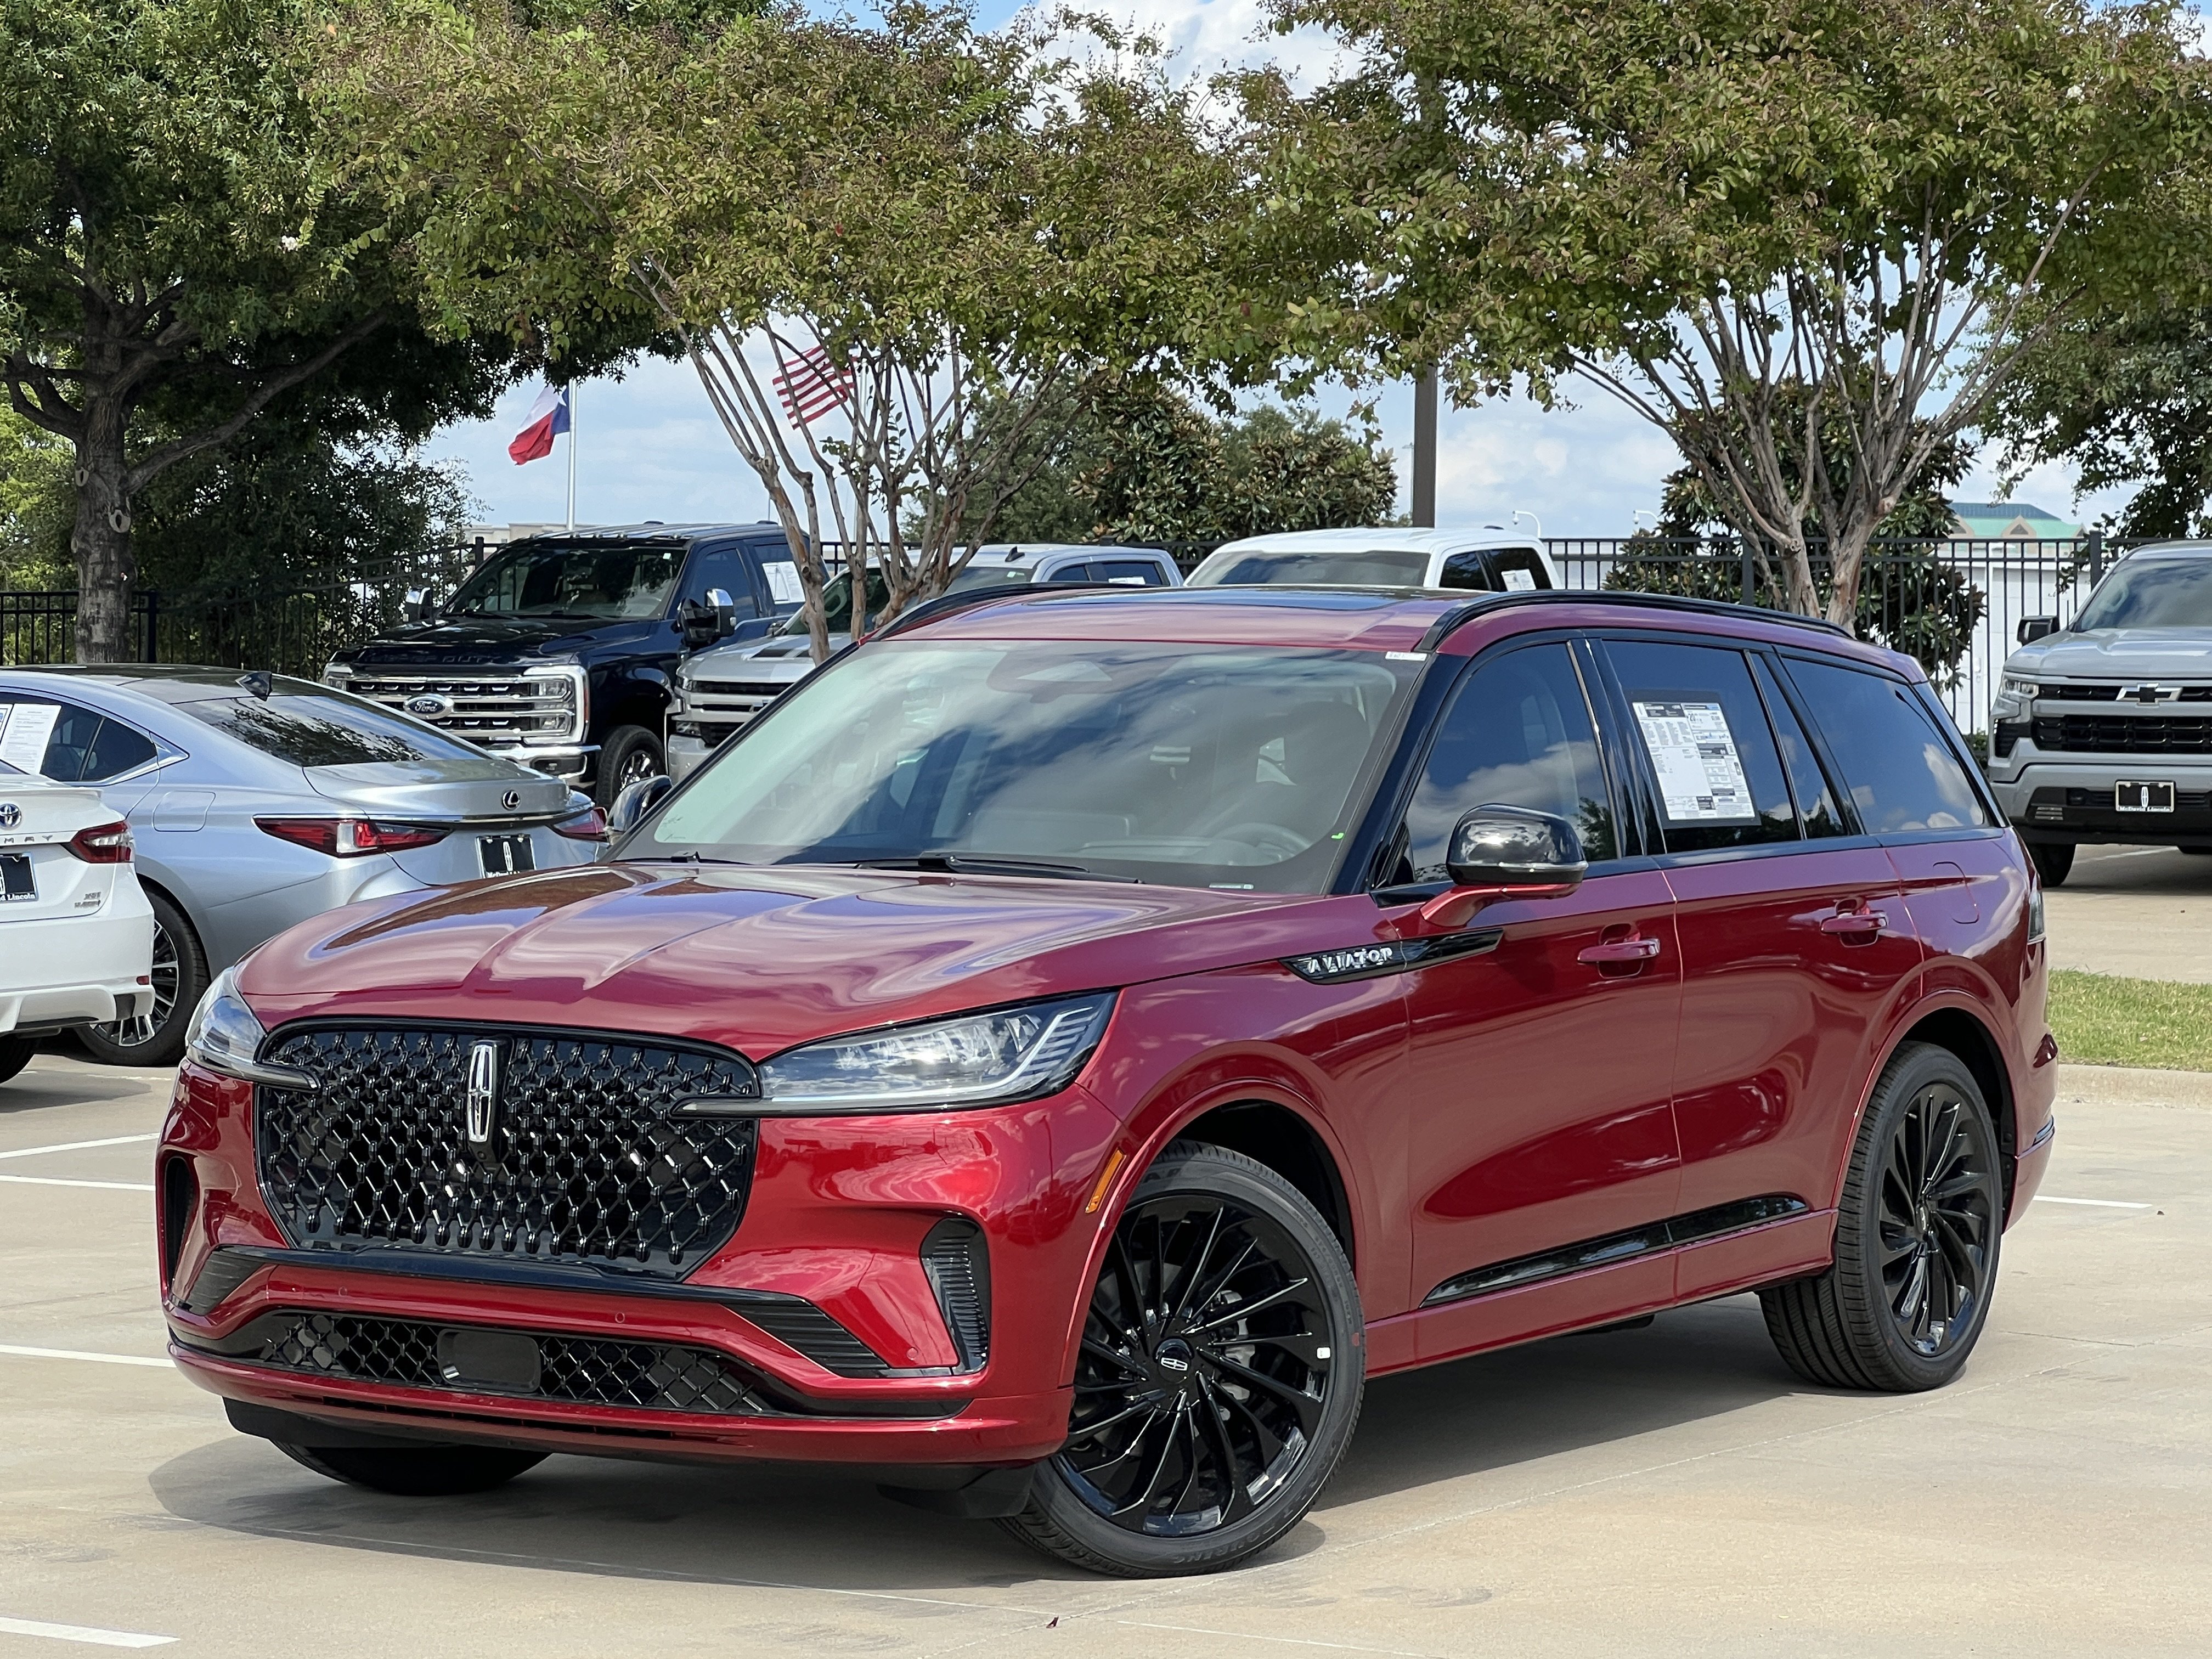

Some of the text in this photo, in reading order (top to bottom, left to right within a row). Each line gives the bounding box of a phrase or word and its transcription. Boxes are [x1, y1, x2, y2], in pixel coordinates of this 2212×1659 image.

[414, 700, 438, 712] Ford
[4, 835, 53, 844] MRY
[1307, 947, 1393, 973] AVIATOR
